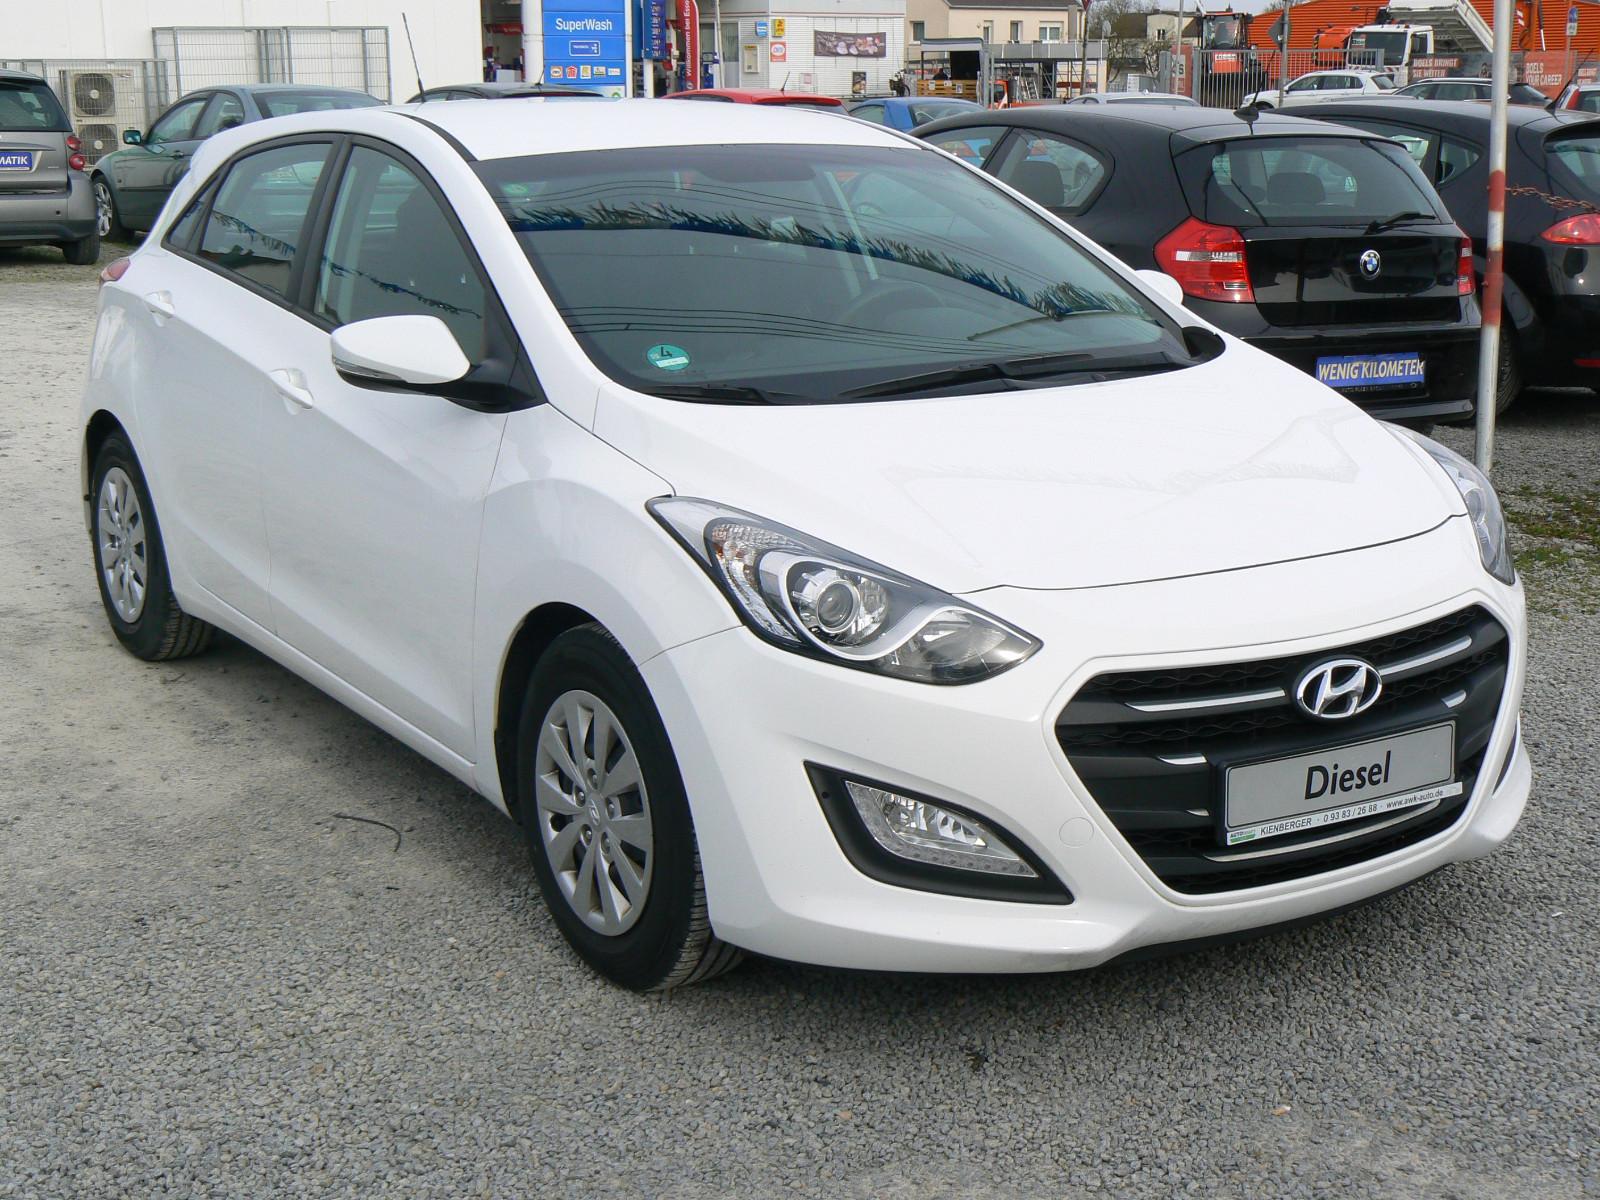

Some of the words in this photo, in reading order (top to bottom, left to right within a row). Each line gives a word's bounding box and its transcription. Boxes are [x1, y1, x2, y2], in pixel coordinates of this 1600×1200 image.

[555, 17, 613, 32] SuperWash
[1540, 74, 1562, 86] CAREER
[1318, 362, 1359, 380] WENIG
[1360, 359, 1425, 378] KILOMETER
[1304, 750, 1391, 800] Diesel
[1260, 817, 1312, 836] KIENBERGER
[1323, 813, 1329, 823] 0
[1330, 811, 1340, 822] 93
[1341, 809, 1351, 820] 83
[1357, 806, 1367, 817] 26
[1368, 803, 1378, 814] 88
[1386, 788, 1444, 810] www.awk-auto.de
